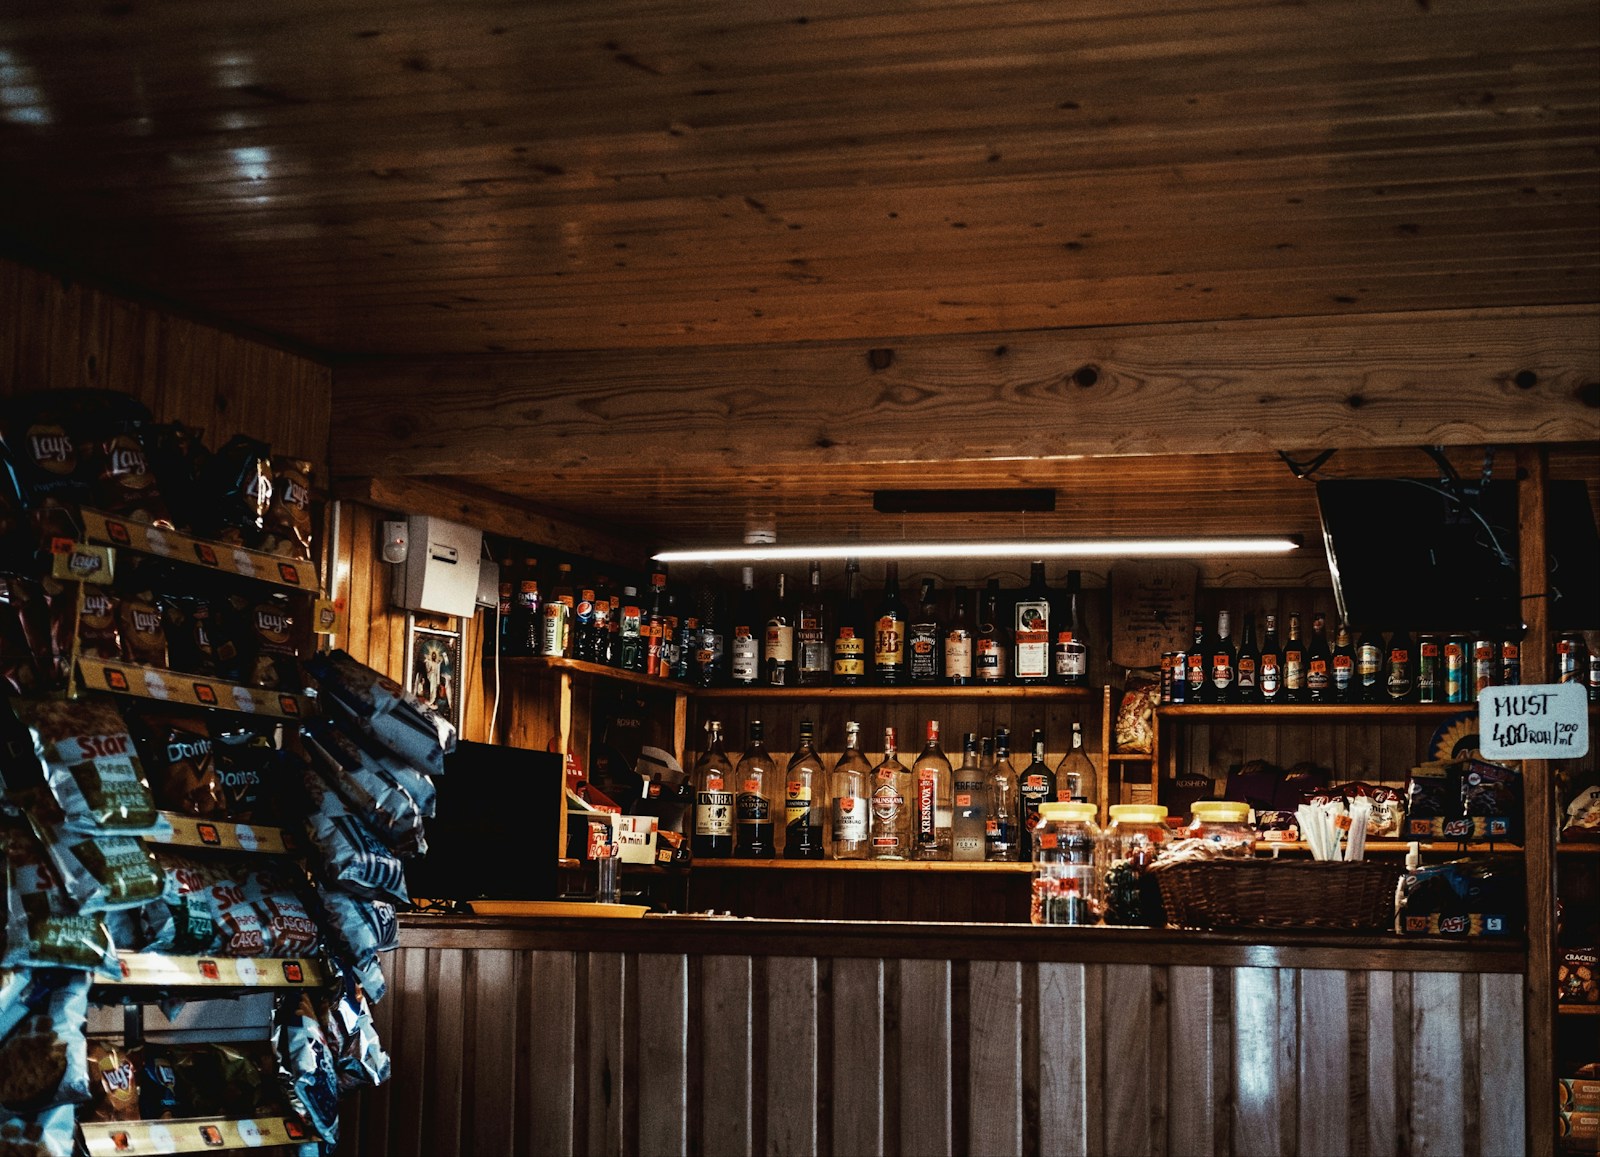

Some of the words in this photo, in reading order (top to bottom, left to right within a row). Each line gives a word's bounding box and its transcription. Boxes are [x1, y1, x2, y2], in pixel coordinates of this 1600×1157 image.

[1494, 694, 1558, 717] MUST
[77, 736, 127, 758] Star
[1559, 733, 1573, 746] ml
[1176, 779, 1208, 788] ROSHEN
[701, 794, 732, 805] UNIREA
[921, 788, 932, 833] KRESKOVA
[627, 834, 643, 845] mini
[188, 917, 213, 937] PIZZA
